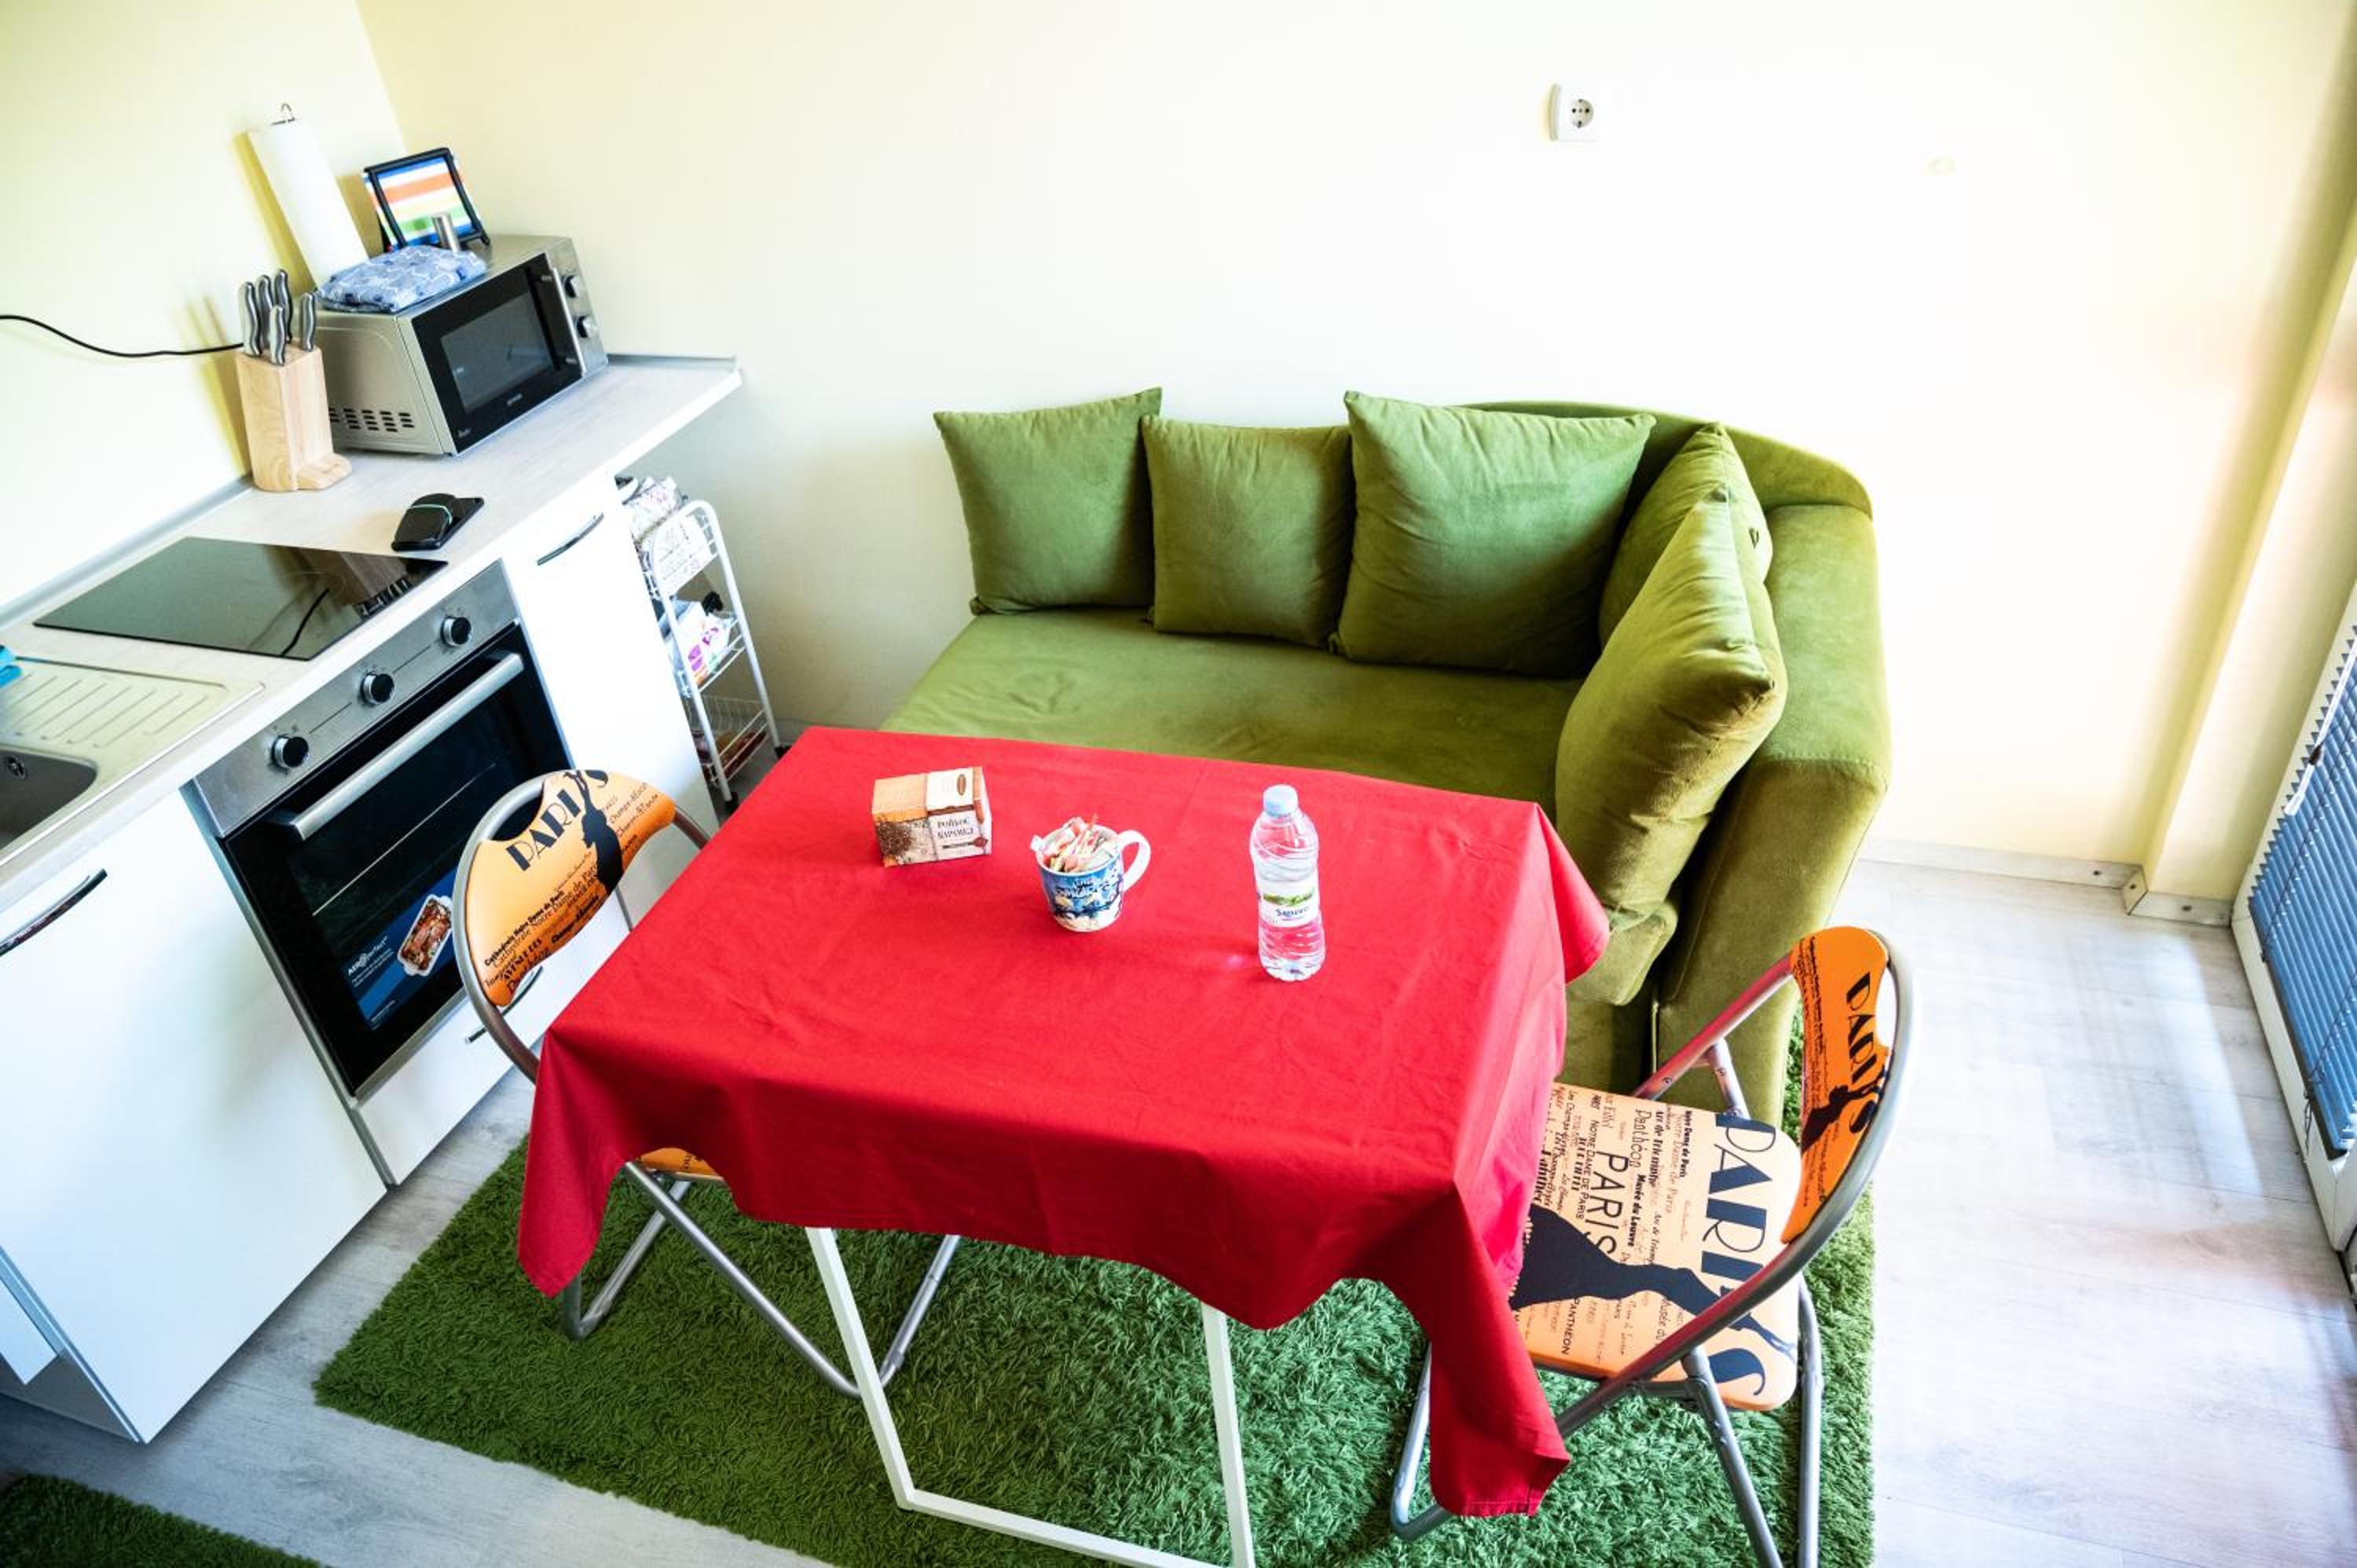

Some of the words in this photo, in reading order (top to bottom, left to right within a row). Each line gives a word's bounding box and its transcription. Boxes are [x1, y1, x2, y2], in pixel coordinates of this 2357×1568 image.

[1682, 1127, 1692, 1147] Dame
[1681, 1148, 1690, 1157] de
[1582, 1150, 1629, 1255] PARIS
[1631, 1202, 1642, 1215] du
[1626, 1216, 1640, 1247] Louvre
